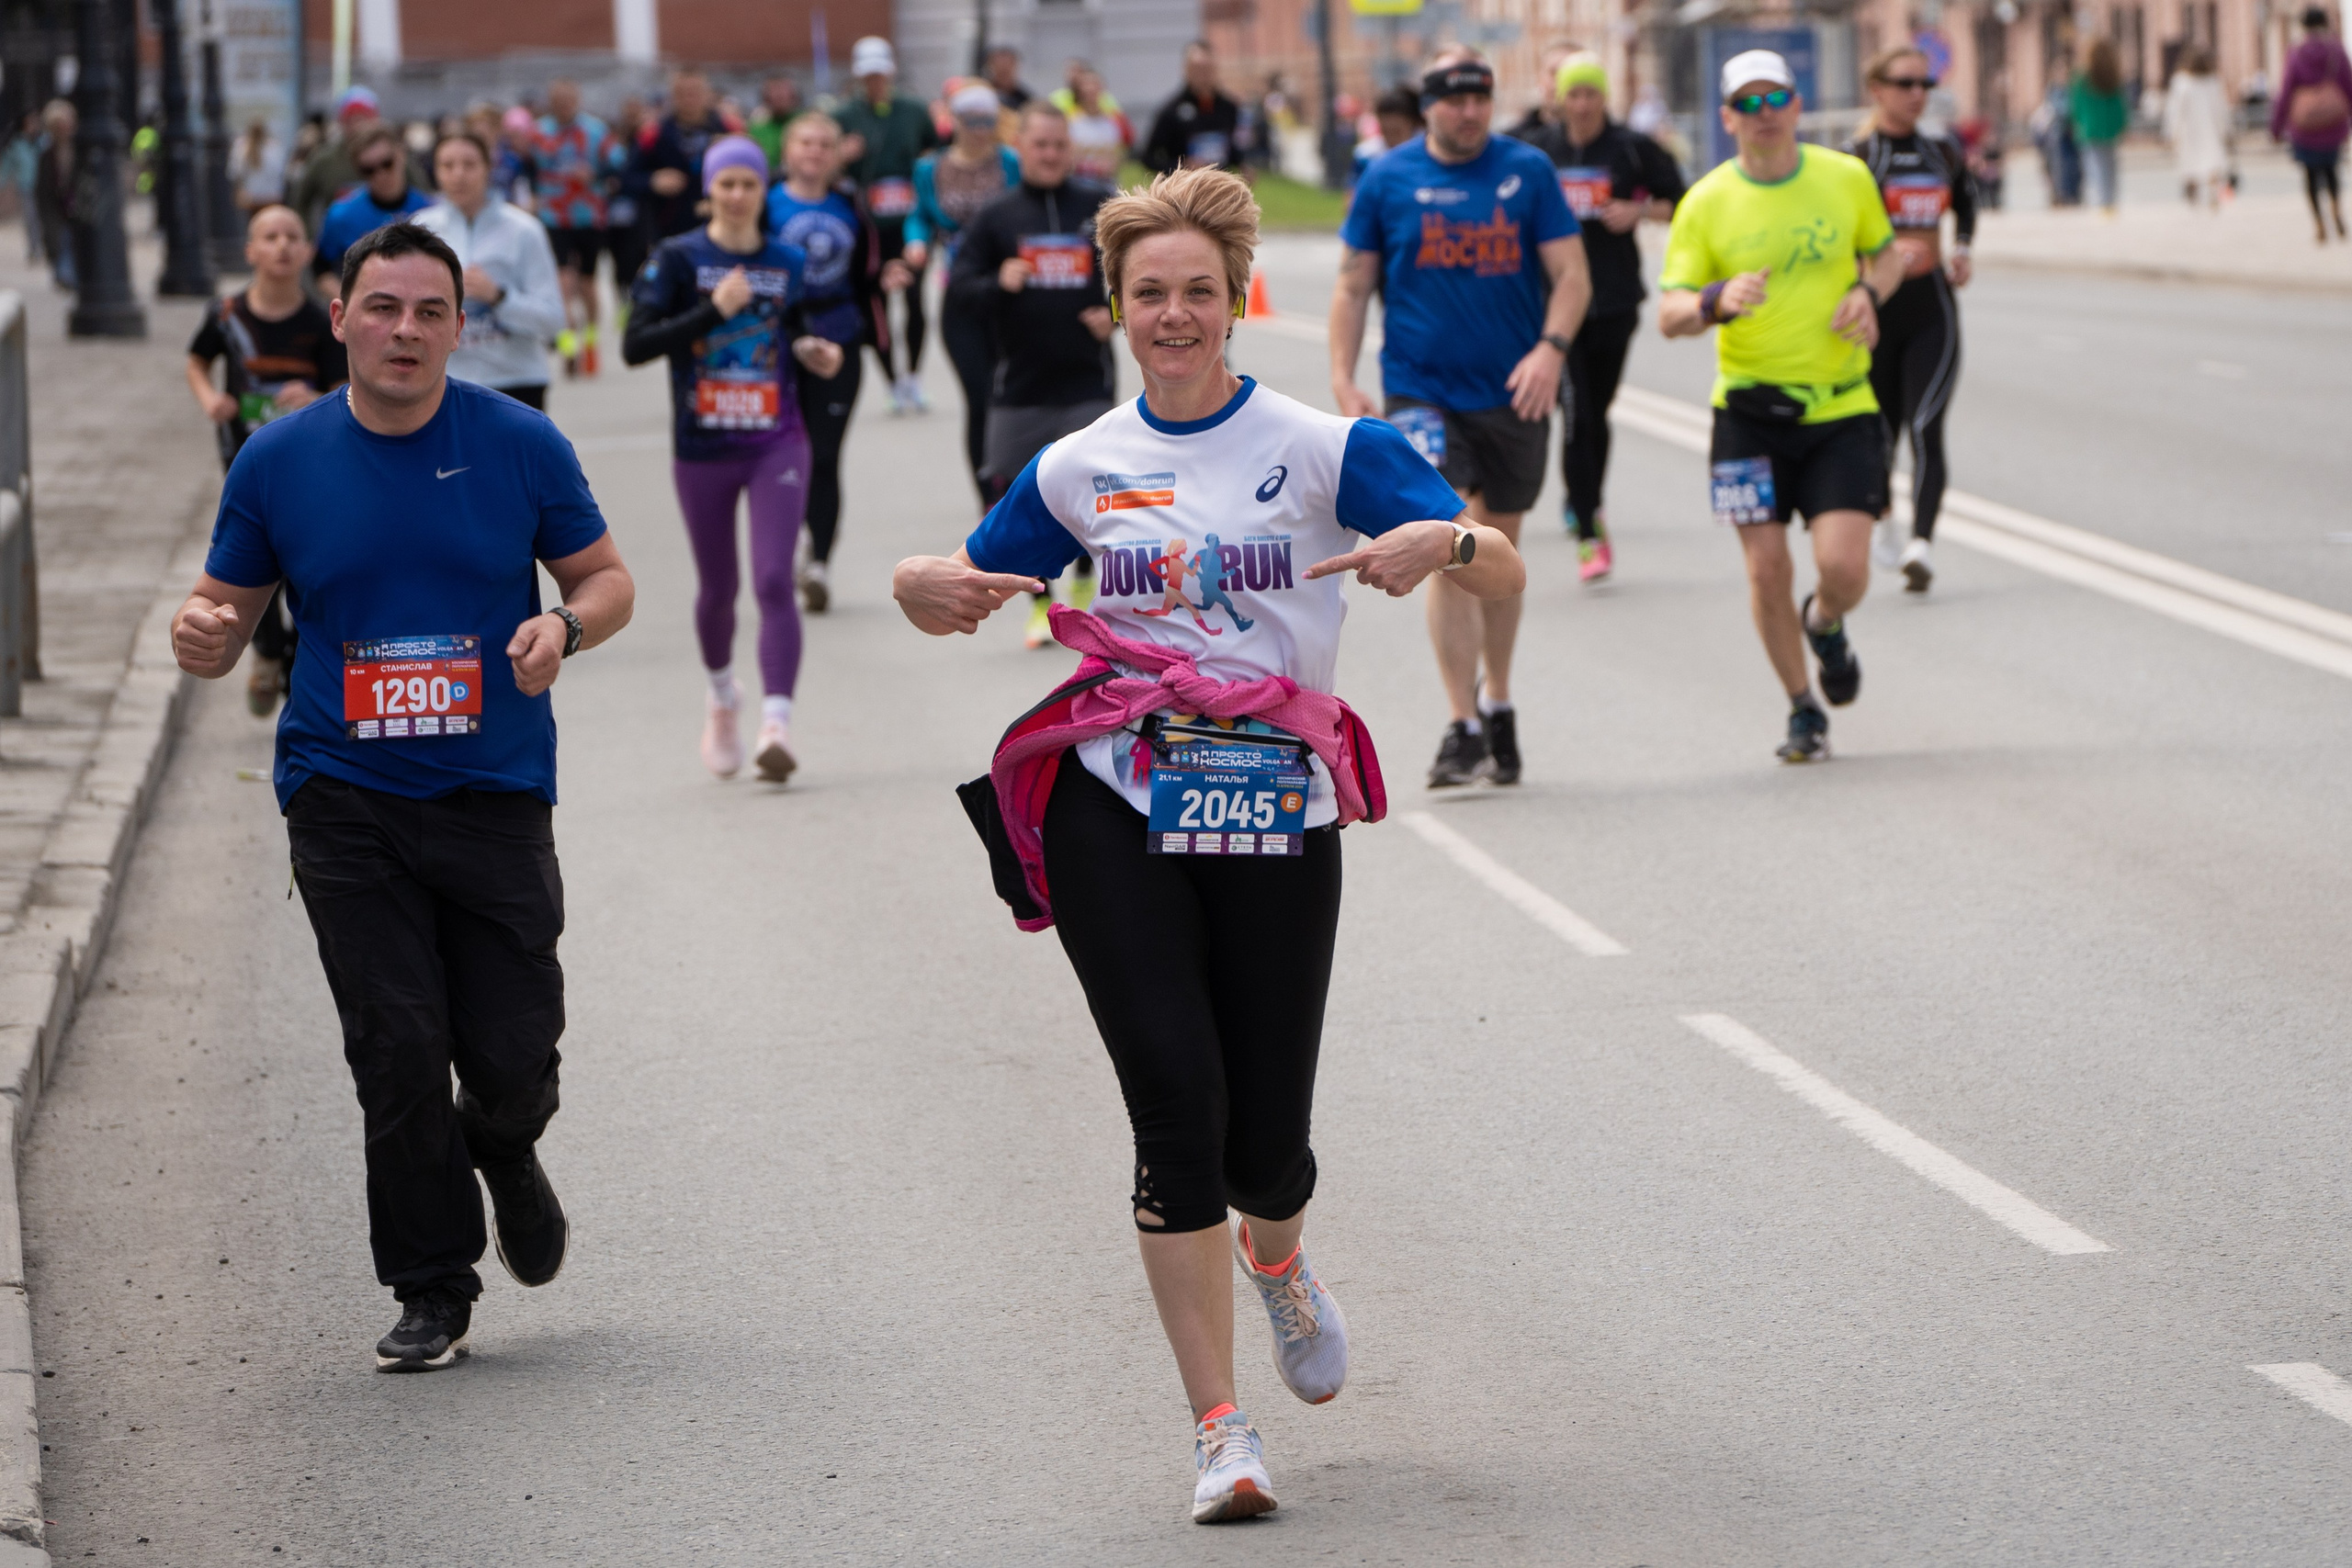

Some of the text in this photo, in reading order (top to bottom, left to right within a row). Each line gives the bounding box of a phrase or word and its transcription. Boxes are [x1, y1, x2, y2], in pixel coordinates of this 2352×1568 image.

[1110, 477, 1173, 487] vk.com/donrun
[1101, 542, 1294, 597] DON RUN
[390, 641, 436, 650] ПРОСТО
[381, 648, 436, 658] КОСМОС
[380, 662, 433, 673] СТАНИСЛАВ
[371, 676, 451, 715] 1290
[454, 686, 466, 698] D
[1210, 750, 1262, 760] ПРОСТО
[1200, 759, 1262, 768] КОСМОС
[1159, 773, 1172, 782] 21,1
[1204, 774, 1249, 784] НАТАЛЬЯ
[1286, 796, 1297, 808] E
[1179, 788, 1276, 829] 2045
